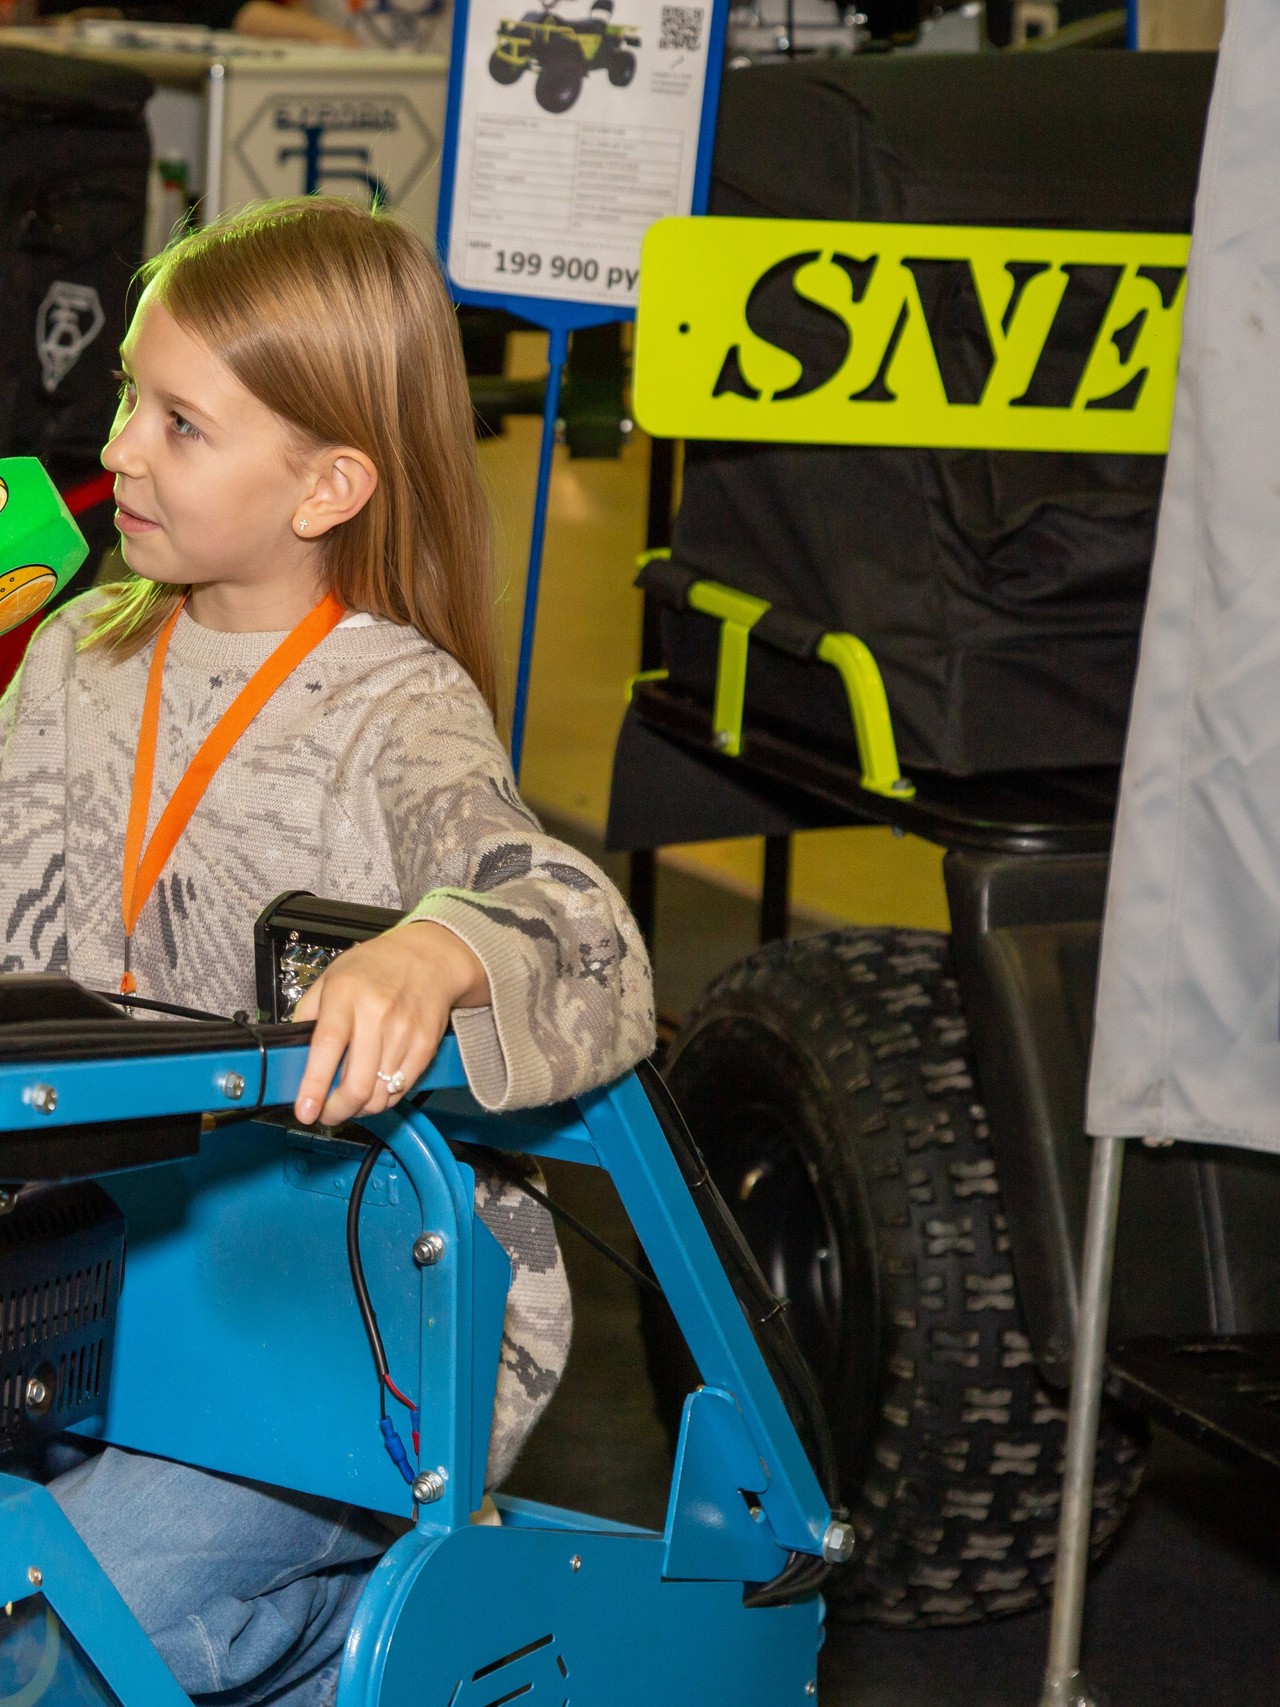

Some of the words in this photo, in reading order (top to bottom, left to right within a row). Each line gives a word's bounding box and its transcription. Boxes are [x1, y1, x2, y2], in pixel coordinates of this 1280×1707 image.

[494, 251, 542, 277] 199
[550, 255, 600, 282] 900
[711, 248, 1187, 411] SNE
